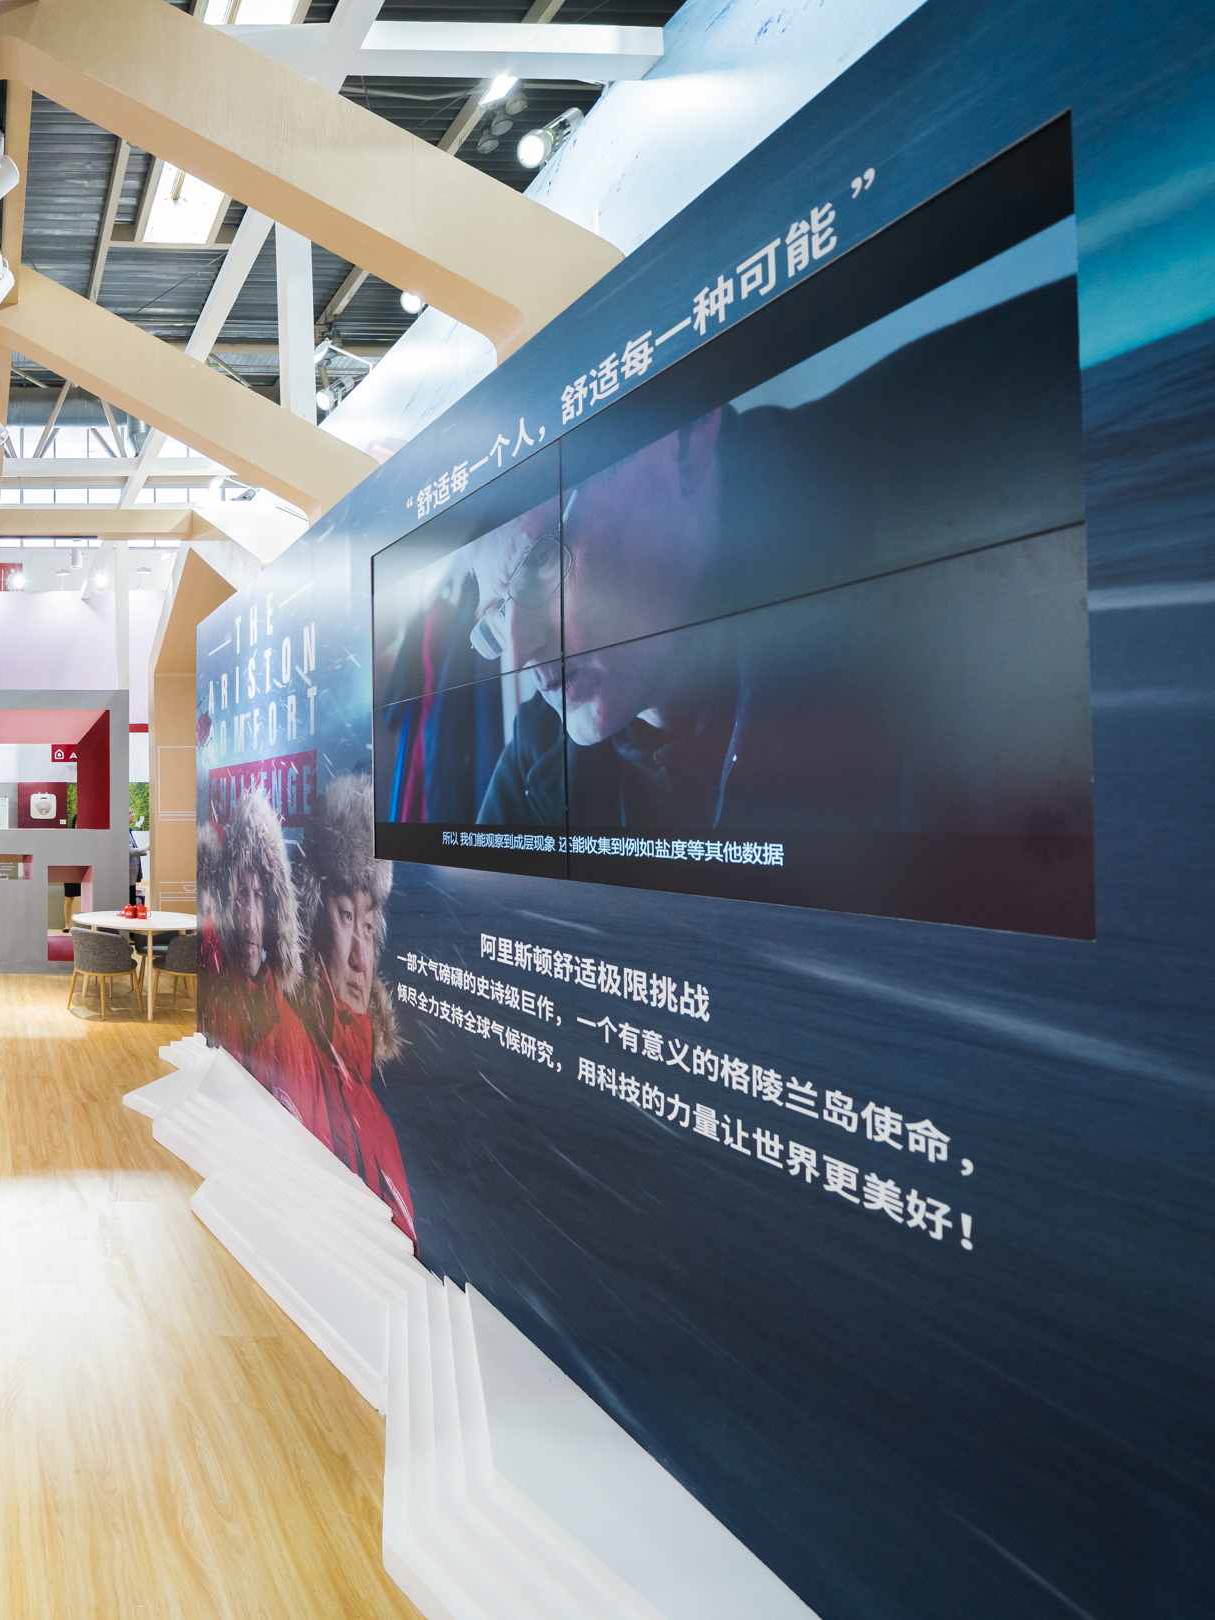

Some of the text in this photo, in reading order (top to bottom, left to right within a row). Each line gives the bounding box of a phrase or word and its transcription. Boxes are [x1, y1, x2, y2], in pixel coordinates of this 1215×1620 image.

[235, 591, 273, 654] THE
[208, 621, 315, 715] ARISTON
[442, 831, 784, 866] 所以 我们能观察到成层现象 还能收集到例如盐度等其他数据
[480, 933, 711, 1022] 阿里斯顿舒适极限挑战
